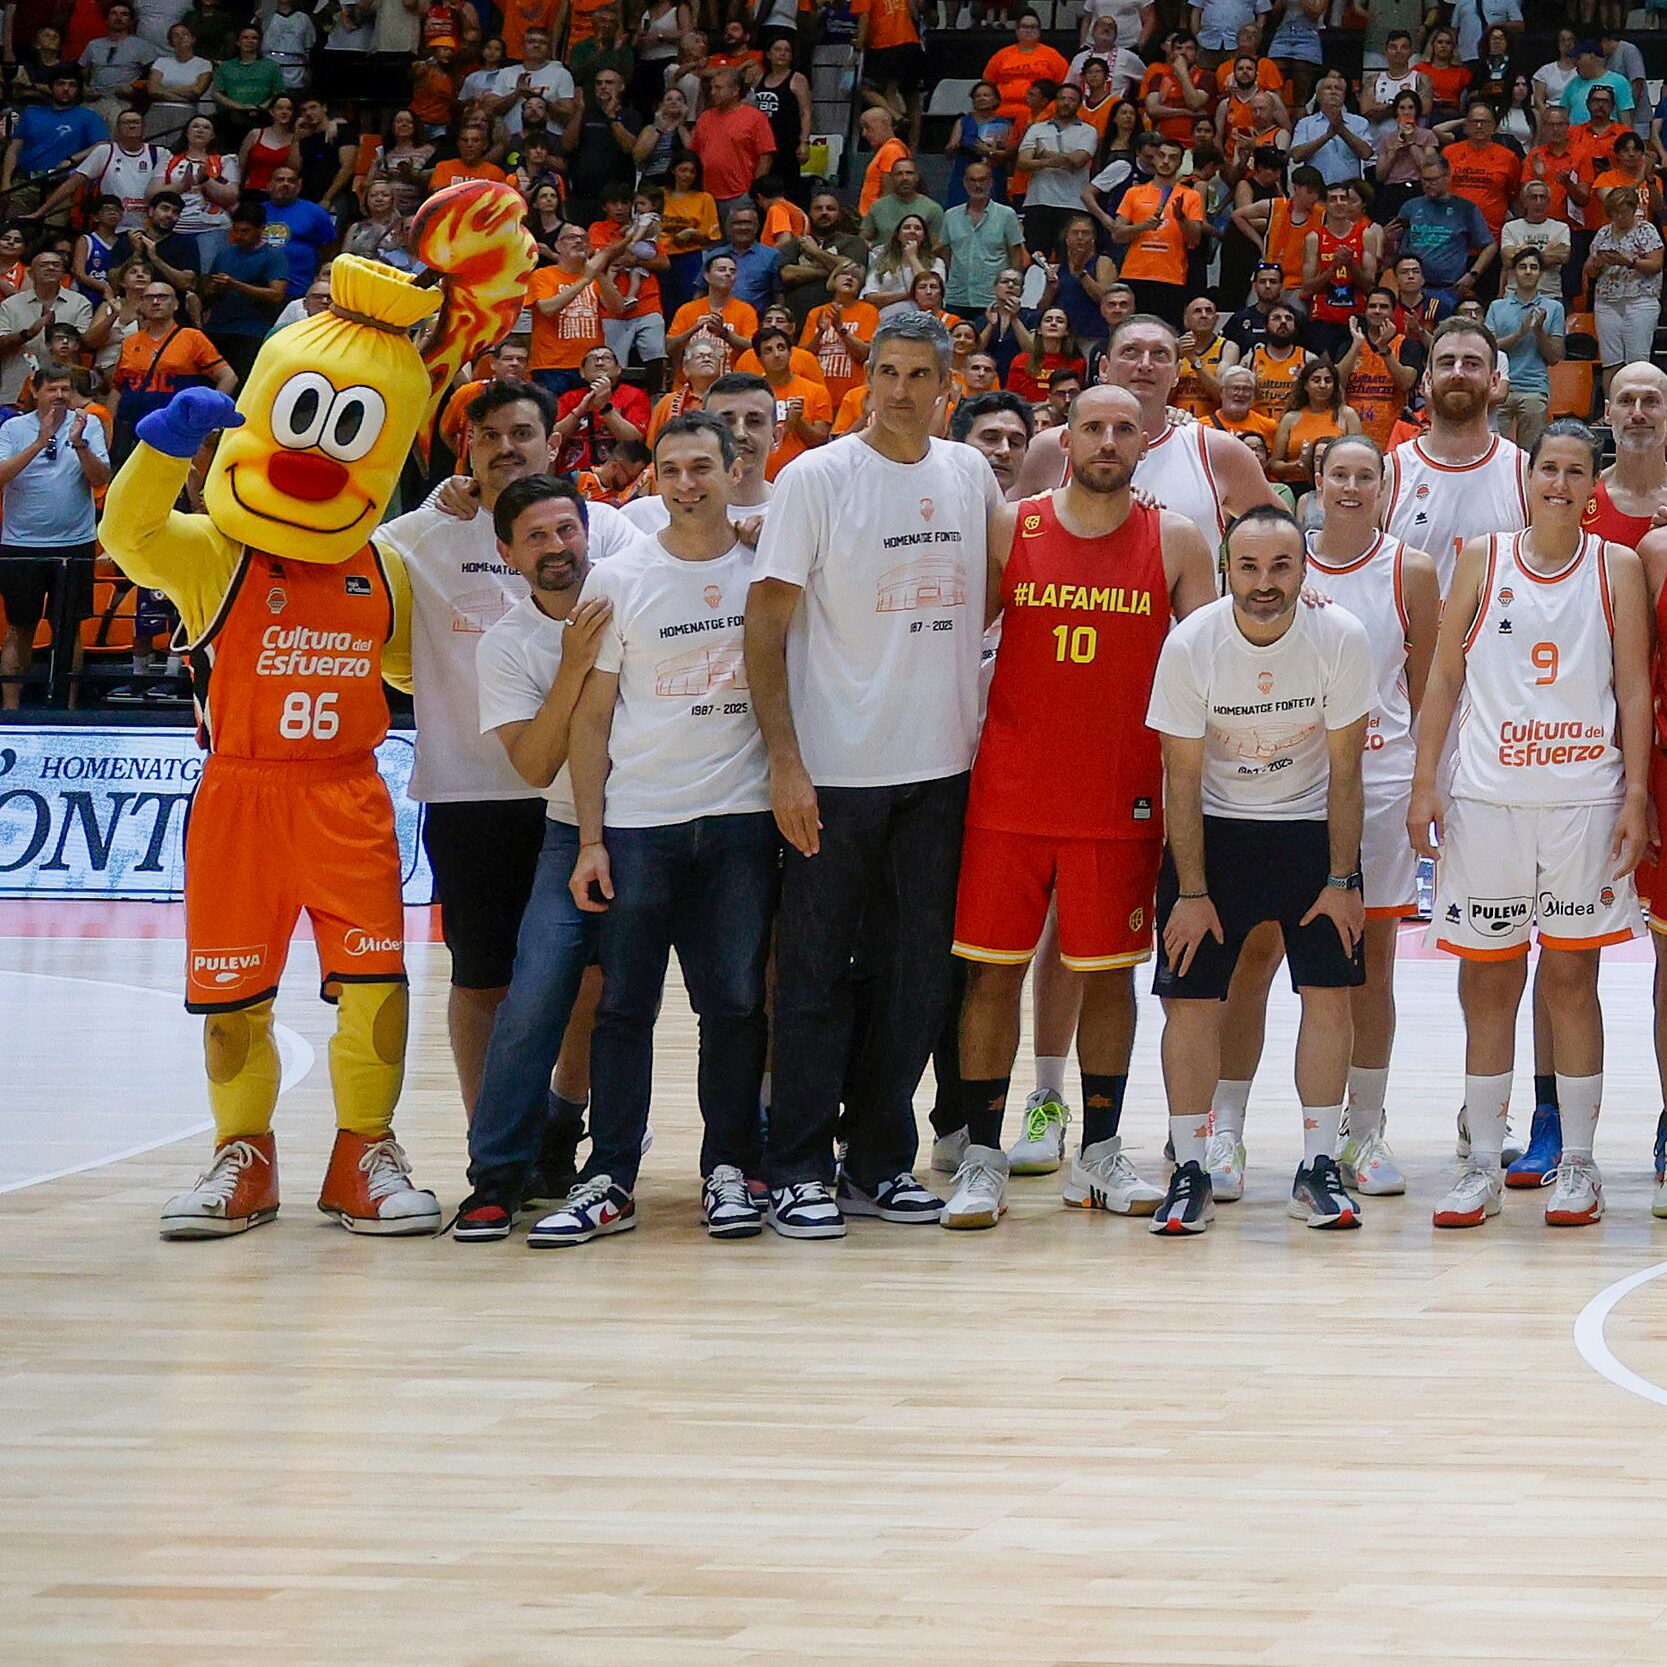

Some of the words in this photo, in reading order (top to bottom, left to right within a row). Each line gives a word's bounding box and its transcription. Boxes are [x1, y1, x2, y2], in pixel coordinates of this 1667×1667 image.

[1012, 581, 1152, 616] #LAFAMILIA
[658, 617, 725, 640] HOMENATGE
[932, 619, 954, 632] 2025
[261, 624, 352, 651] Cultura
[352, 636, 373, 652] del
[1052, 624, 1098, 665] 10
[255, 648, 371, 679] Esfuerzo
[1530, 641, 1559, 686] 9
[278, 691, 341, 741] 86
[690, 702, 713, 717] 1987
[723, 701, 749, 715] 2025
[1213, 701, 1274, 717] HOMENATGE
[1500, 719, 1584, 745] Cultura
[1584, 725, 1605, 739] del
[1499, 742, 1605, 768] Esfuerzo
[1471, 902, 1528, 921] PULEVA
[1548, 898, 1596, 918] Midea
[351, 934, 403, 954] Mide
[193, 953, 261, 972] PULEVA
